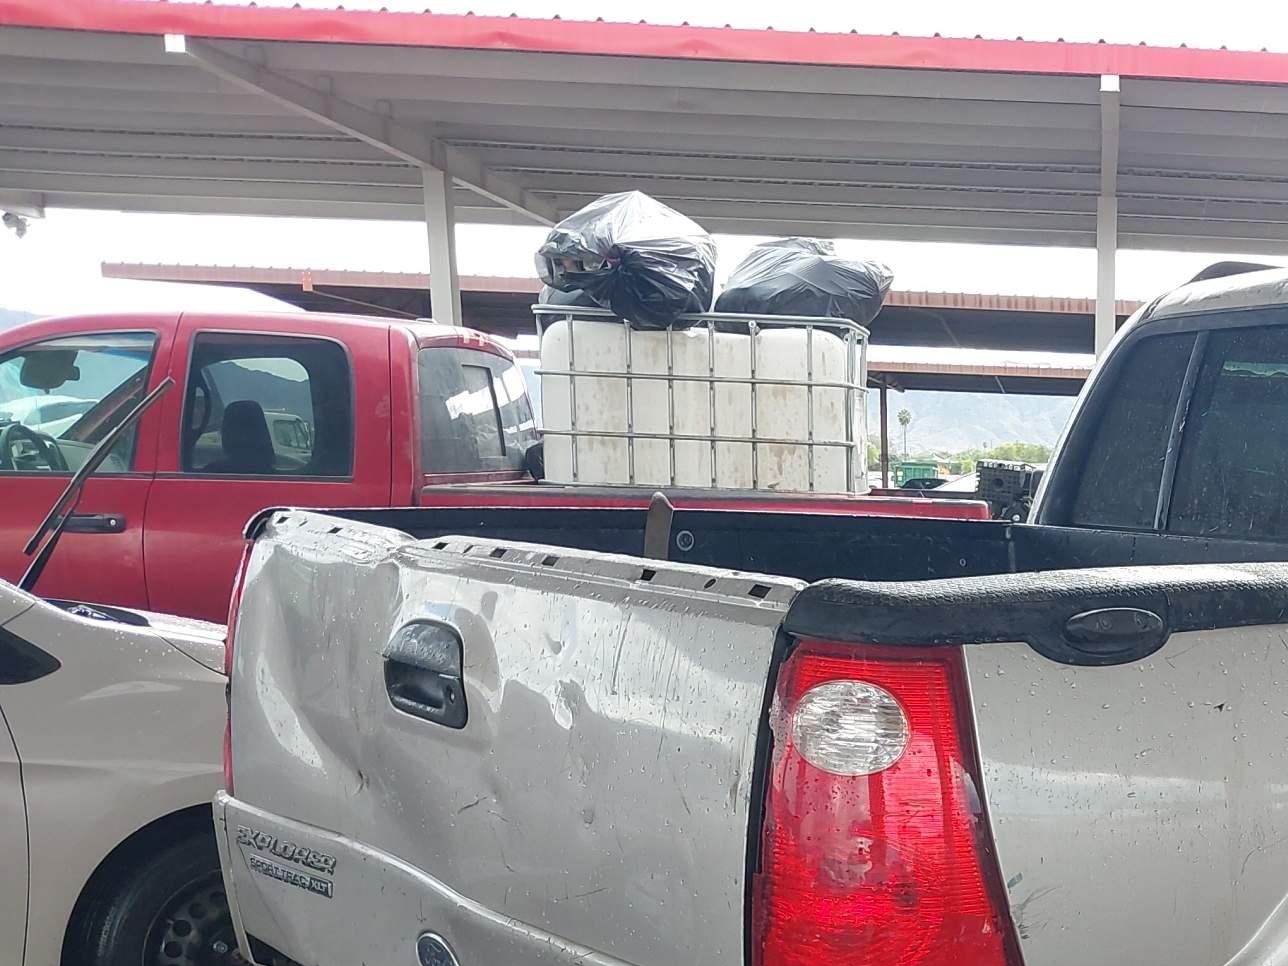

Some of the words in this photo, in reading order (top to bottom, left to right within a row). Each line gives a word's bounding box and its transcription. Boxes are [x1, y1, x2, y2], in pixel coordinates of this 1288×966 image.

[236, 824, 337, 876] EXPLORER
[250, 856, 279, 880] SPORT
[280, 868, 310, 890] TRAC
